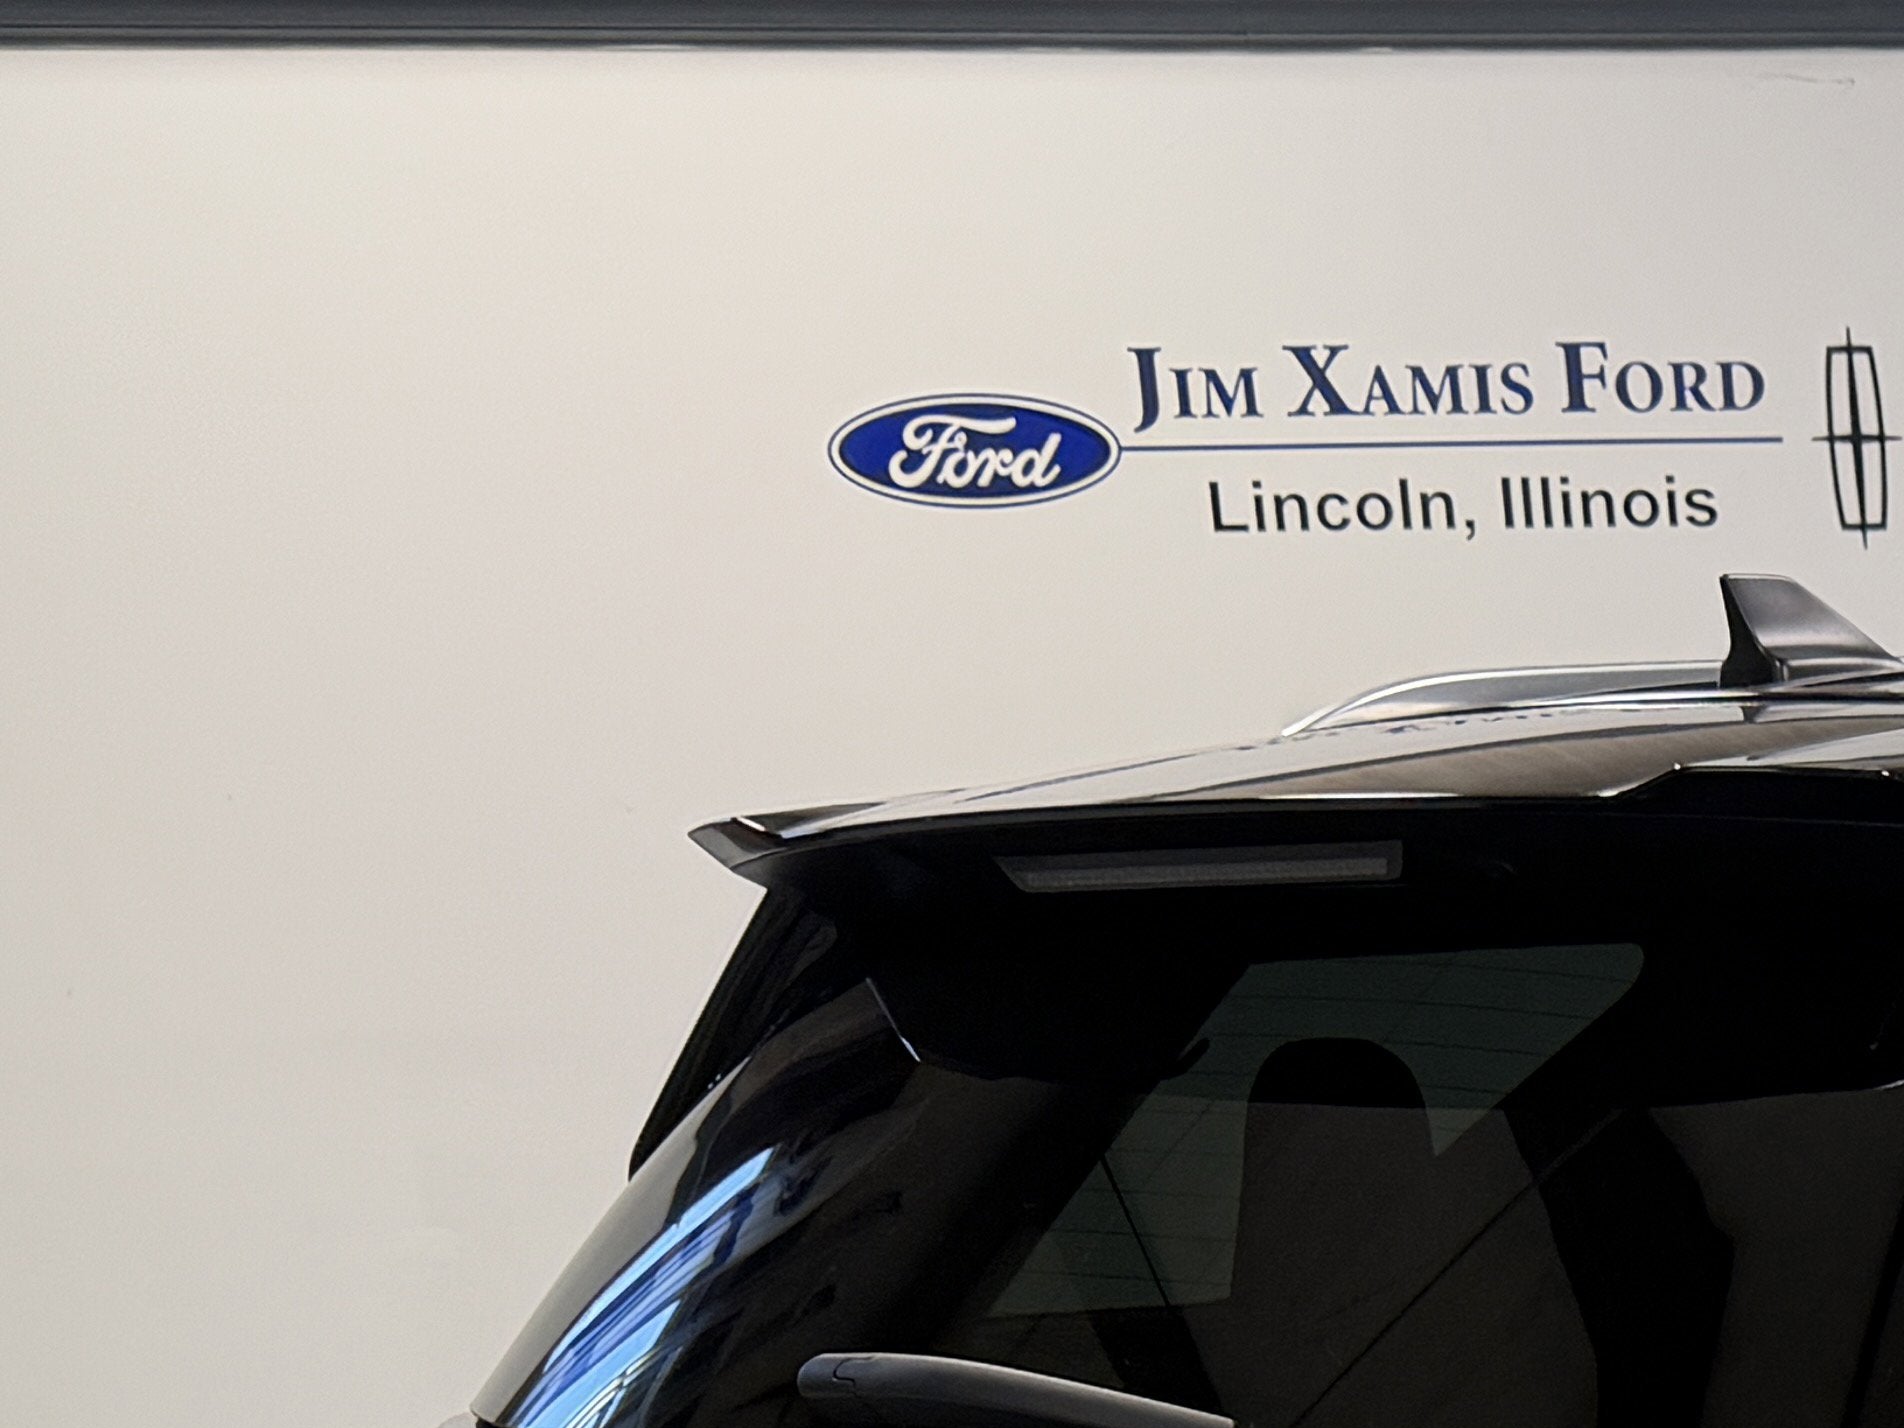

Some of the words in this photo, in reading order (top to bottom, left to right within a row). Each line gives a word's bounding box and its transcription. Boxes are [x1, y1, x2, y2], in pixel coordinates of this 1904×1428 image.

[1126, 347, 1264, 433] JIM
[1281, 344, 1534, 418] XAMIS
[1554, 341, 1765, 414] FORD
[887, 415, 1062, 490] Ford
[1208, 478, 1476, 541] Lincoln,
[1501, 475, 1718, 530] Illinois
